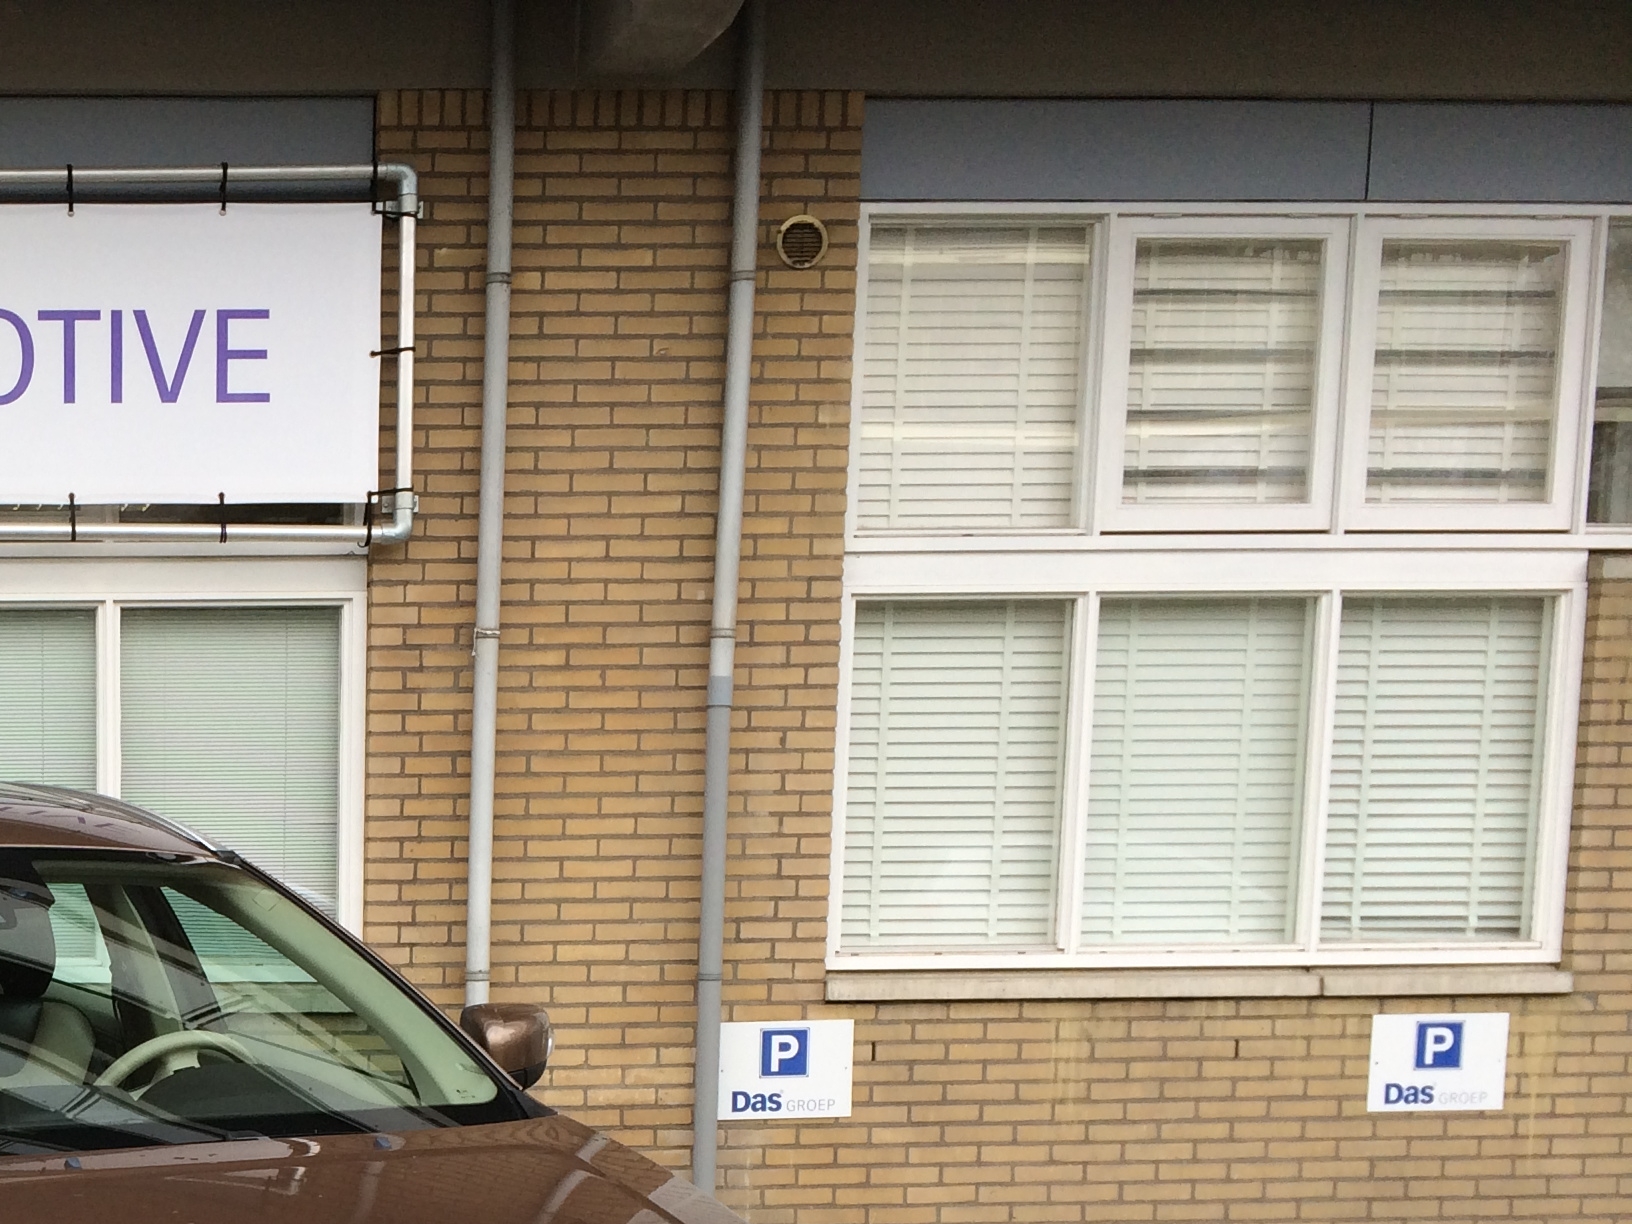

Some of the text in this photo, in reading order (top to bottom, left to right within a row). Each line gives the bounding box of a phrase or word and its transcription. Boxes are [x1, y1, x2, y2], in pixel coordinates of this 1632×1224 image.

[770, 1034, 800, 1073] P
[1424, 1027, 1456, 1065] P
[731, 1090, 836, 1113] Das GROEP
[1384, 1082, 1489, 1105] Das GROEP
